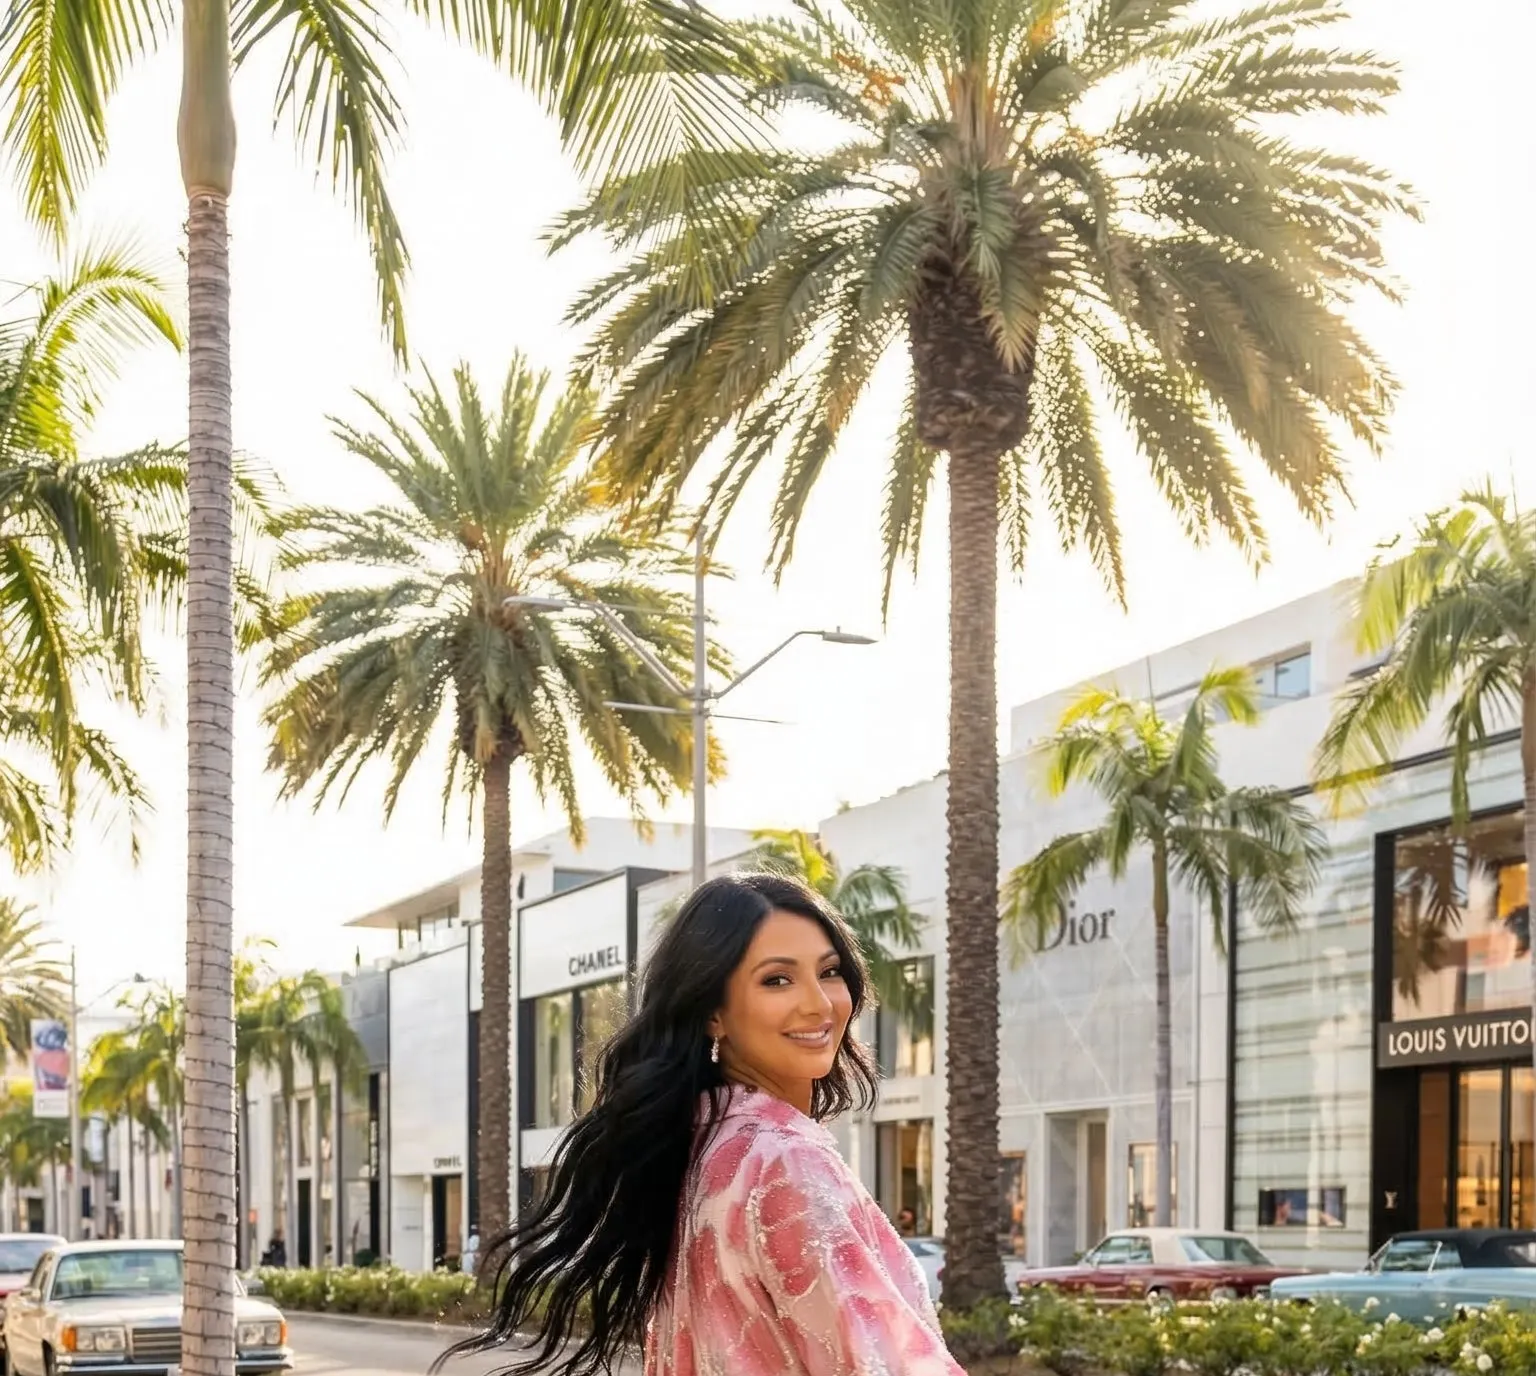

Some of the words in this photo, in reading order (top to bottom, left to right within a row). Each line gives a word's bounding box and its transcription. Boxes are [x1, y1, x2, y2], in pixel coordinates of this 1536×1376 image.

[568, 944, 622, 976] CHANEL
[1388, 1026, 1446, 1056] LOUIS
[1452, 1018, 1535, 1050] VUITTO
